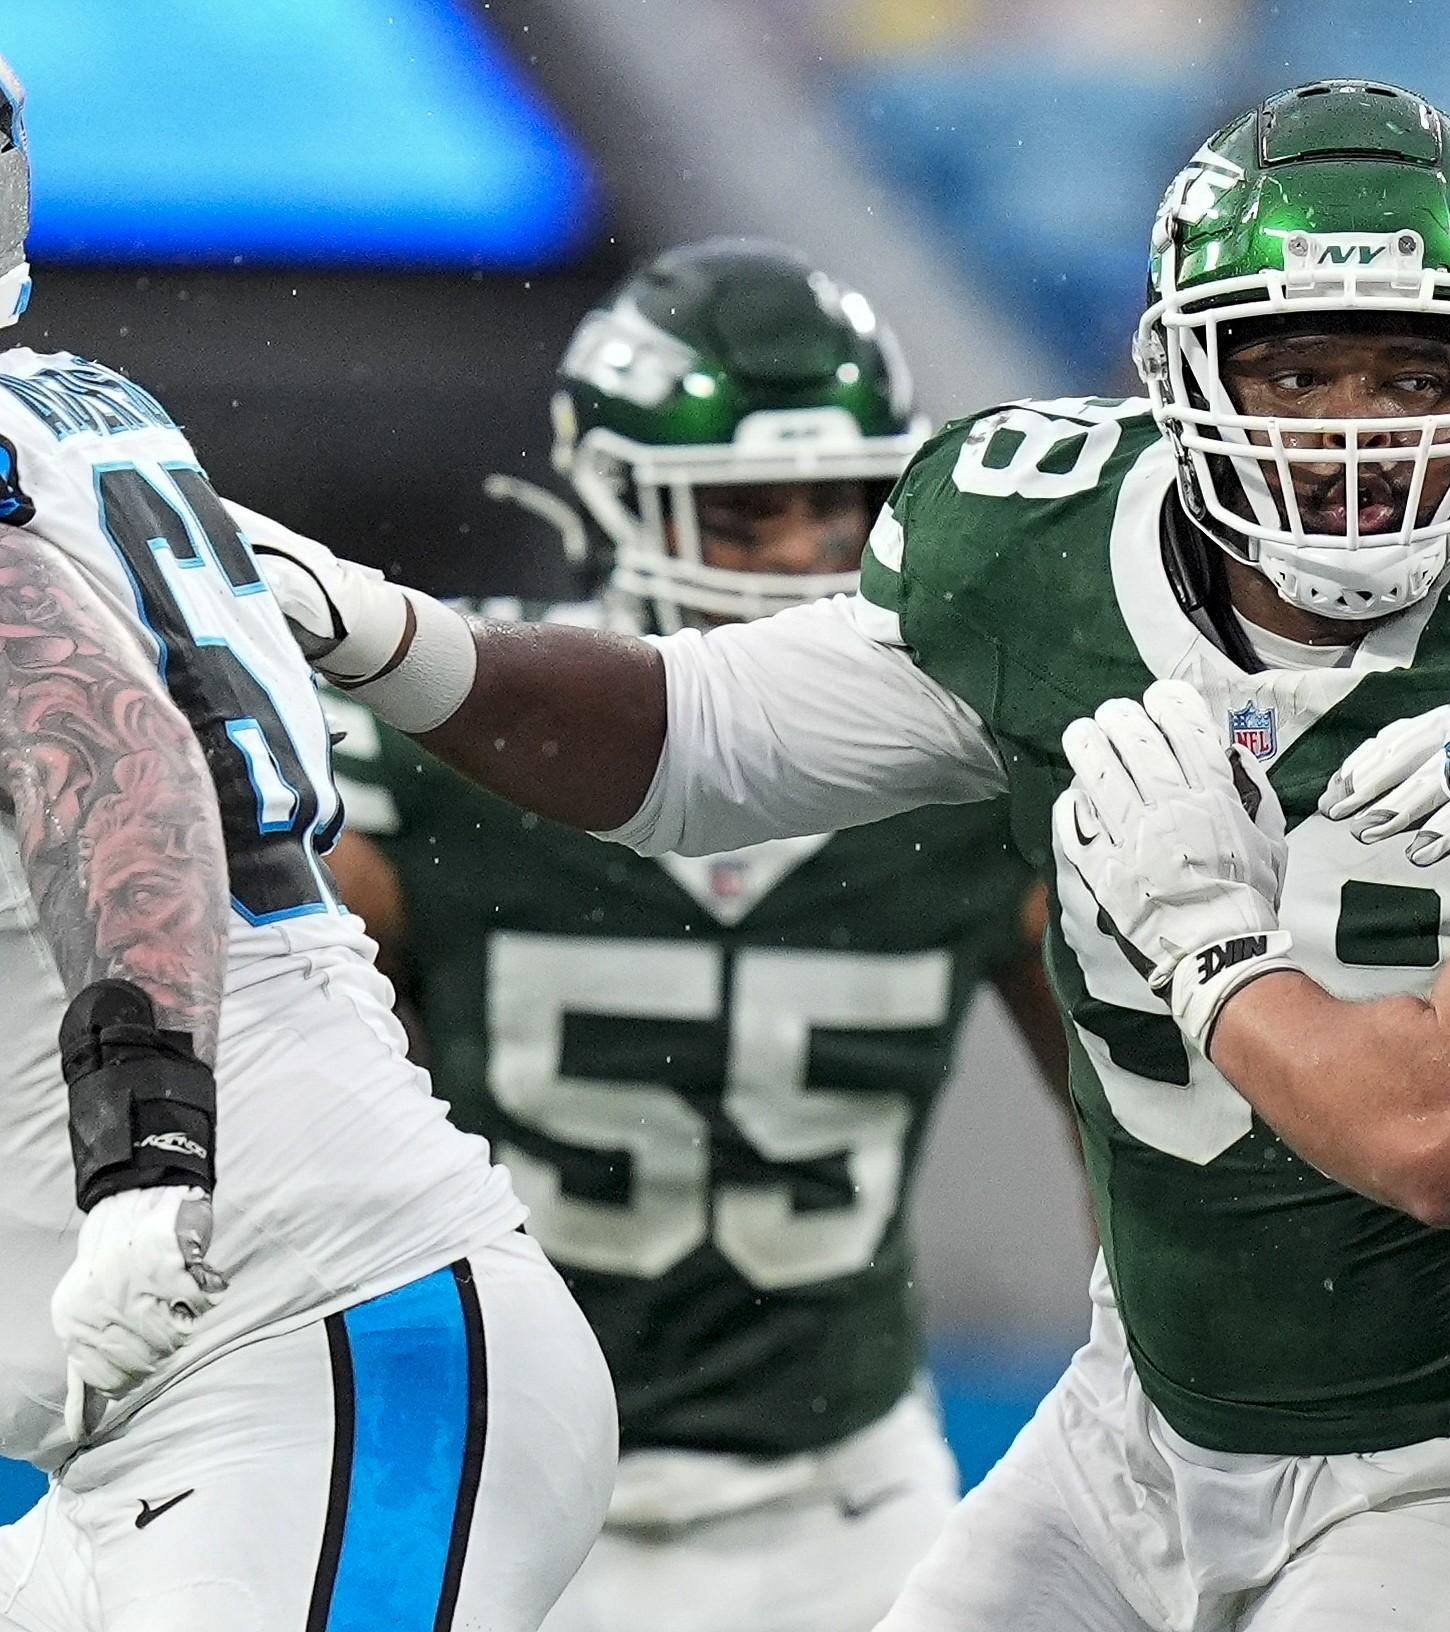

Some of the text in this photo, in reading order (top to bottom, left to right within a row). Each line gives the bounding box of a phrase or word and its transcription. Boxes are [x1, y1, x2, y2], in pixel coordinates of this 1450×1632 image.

[1317, 245, 1387, 265] NY
[1236, 731, 1269, 755] NFL
[1196, 934, 1268, 985] NIKE
[487, 929, 954, 1290] 55
